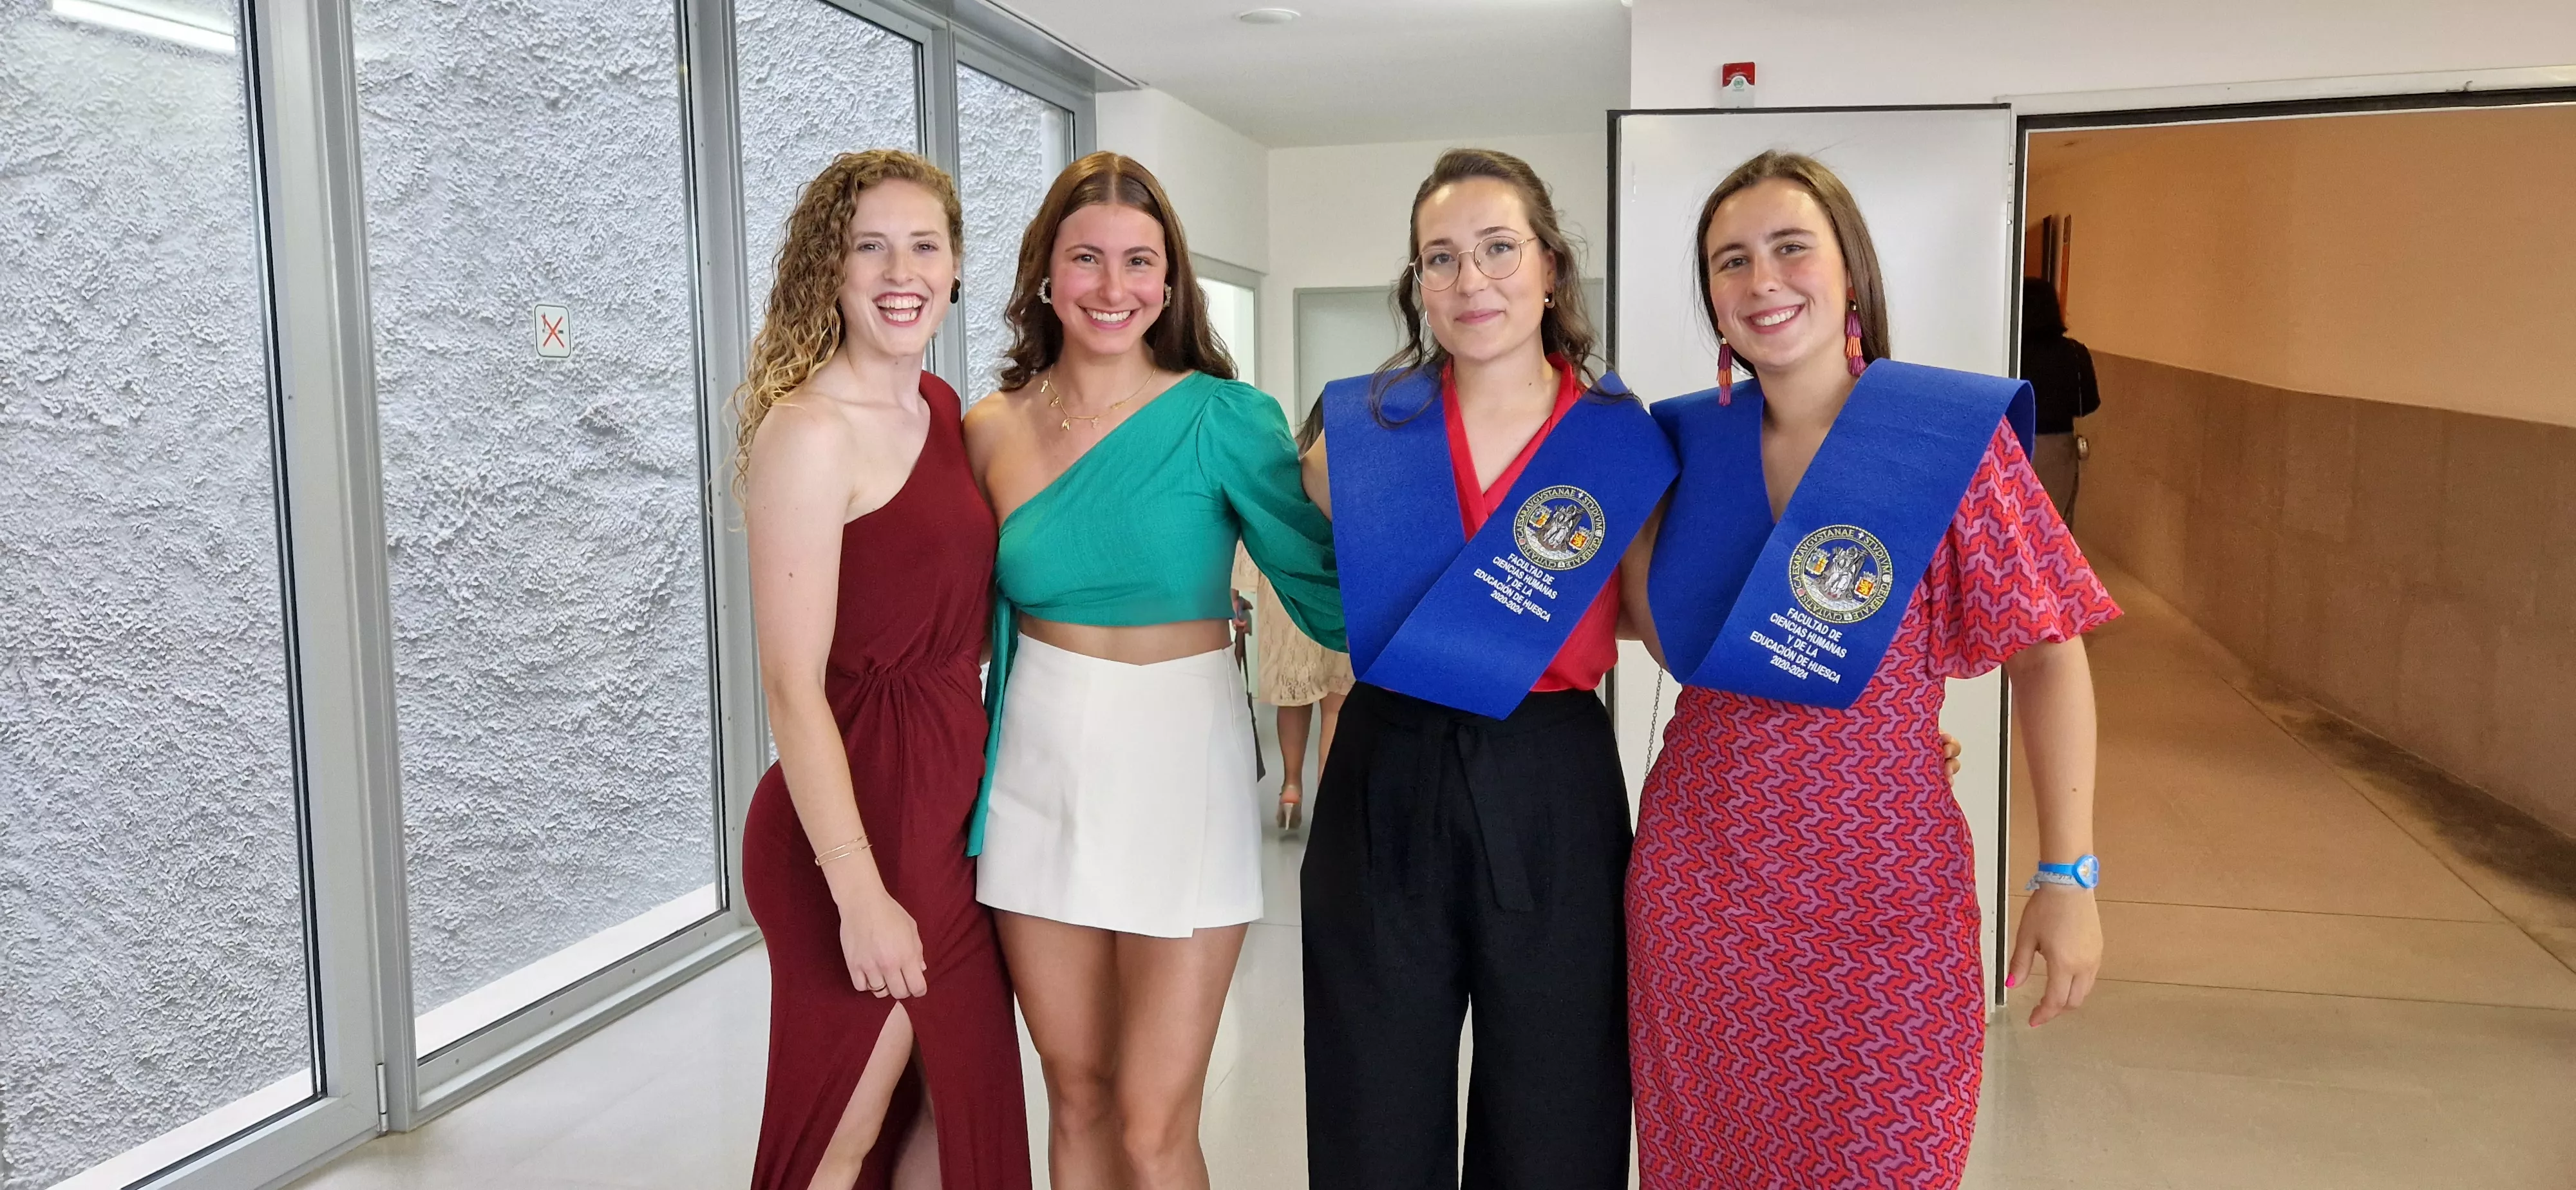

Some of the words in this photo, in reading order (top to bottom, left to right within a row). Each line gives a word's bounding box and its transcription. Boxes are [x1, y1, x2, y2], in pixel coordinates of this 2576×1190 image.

[1508, 553, 1544, 578] FACULTAD
[1542, 573, 1555, 585] DE
[1864, 536, 1889, 574] STVDIVM
[1493, 556, 1524, 578] CIENCIAS
[1523, 574, 1558, 600] HUMANAS
[1506, 574, 1513, 583] Y
[1511, 579, 1523, 590] DE
[1522, 585, 1533, 597] LA
[1473, 568, 1514, 597] EDUCACIÓN
[1513, 592, 1524, 603] DE
[1522, 599, 1551, 622] HUESCA
[1490, 590, 1524, 614] 2020-2024
[1770, 613, 1807, 638] CIENCIAS
[1806, 632, 1847, 657] HUMANAS
[1787, 608, 1829, 634] FACULTAD
[1828, 628, 1842, 641] DE
[1750, 630, 1797, 661] EDUCACIÓN
[1795, 654, 1809, 666] DE
[1808, 661, 1841, 683] HUESCA
[1787, 634, 1794, 643] Y
[1794, 639, 1807, 651] DE
[1806, 645, 1818, 657] LA
[1770, 656, 1808, 679] 2020-2024
